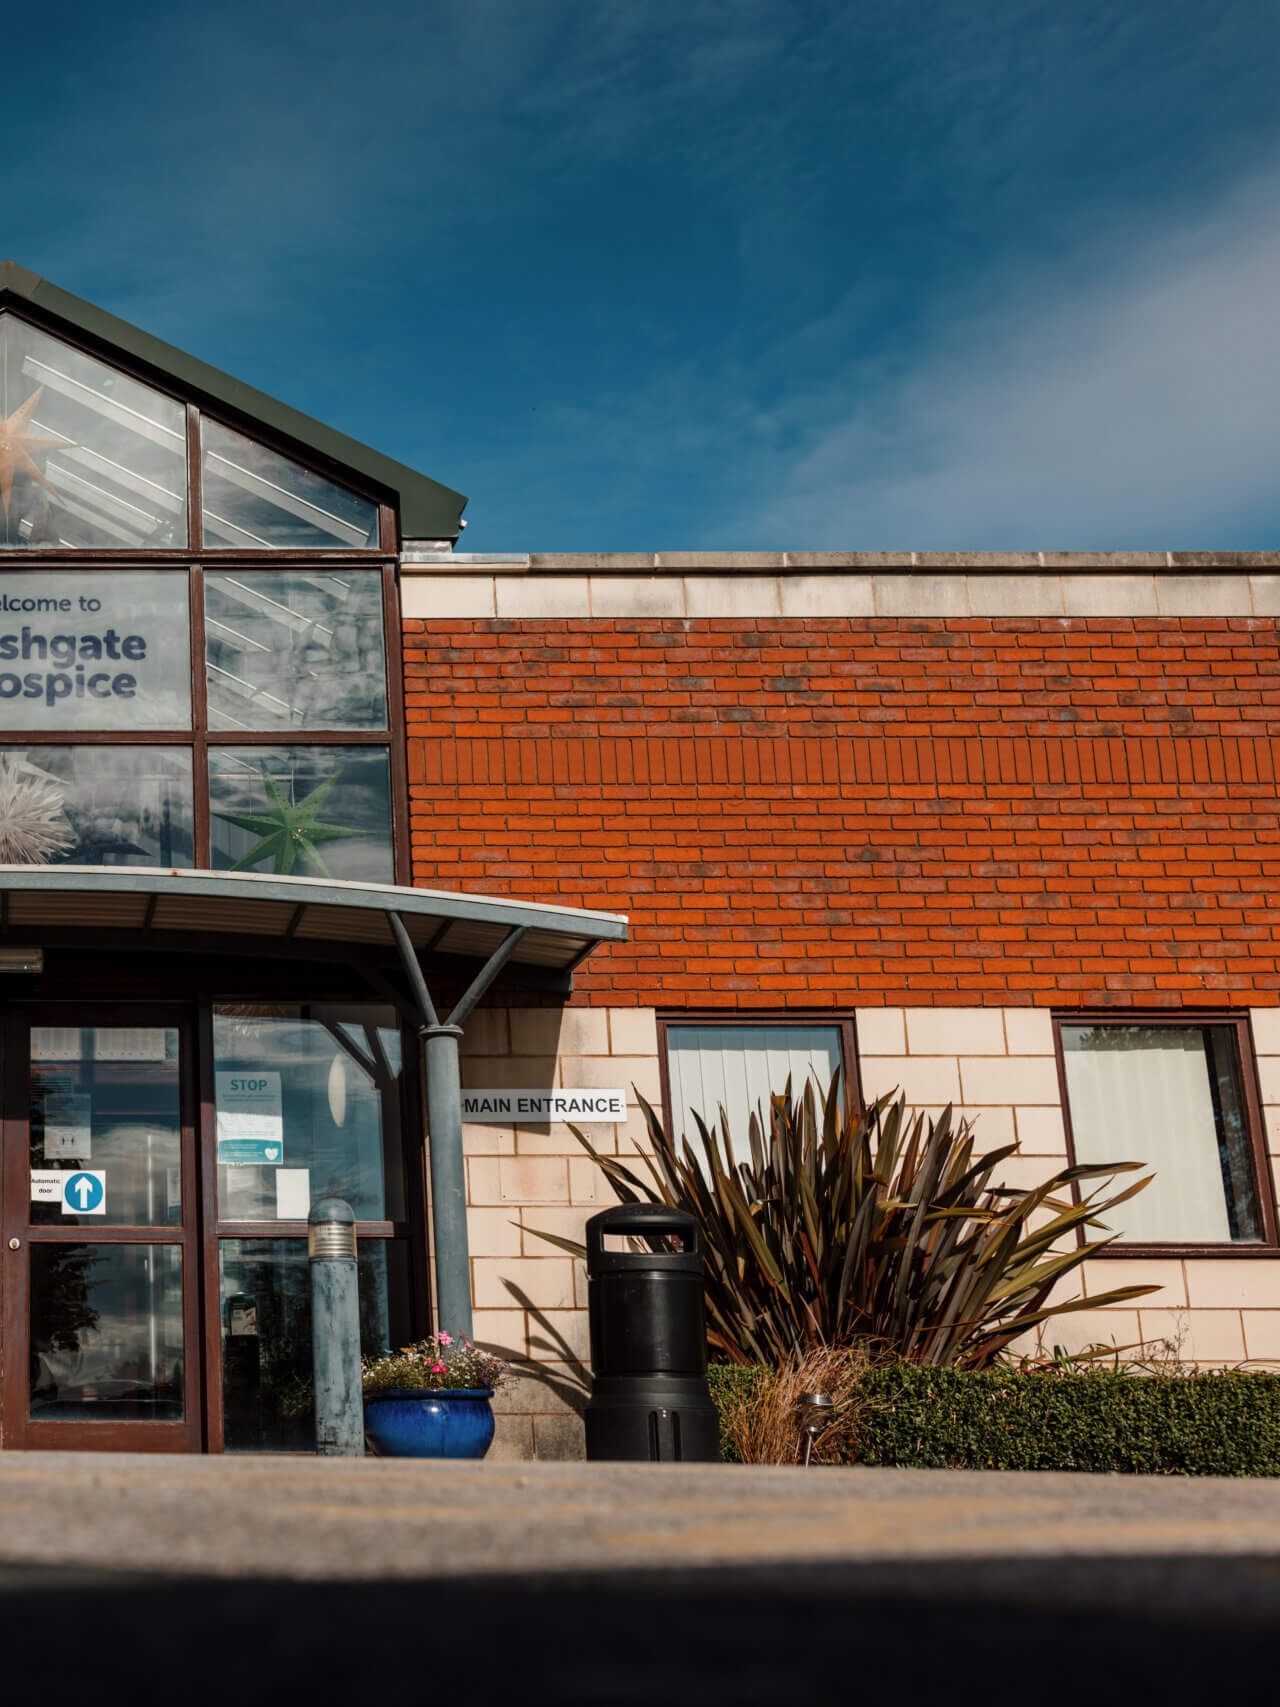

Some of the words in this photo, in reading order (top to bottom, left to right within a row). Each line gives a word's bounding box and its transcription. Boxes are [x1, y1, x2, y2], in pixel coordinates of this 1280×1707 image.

[78, 594, 101, 612] to
[231, 1079, 268, 1091] STOP
[464, 1098, 511, 1113] MAIN
[517, 1098, 620, 1113] ENTRANCE
